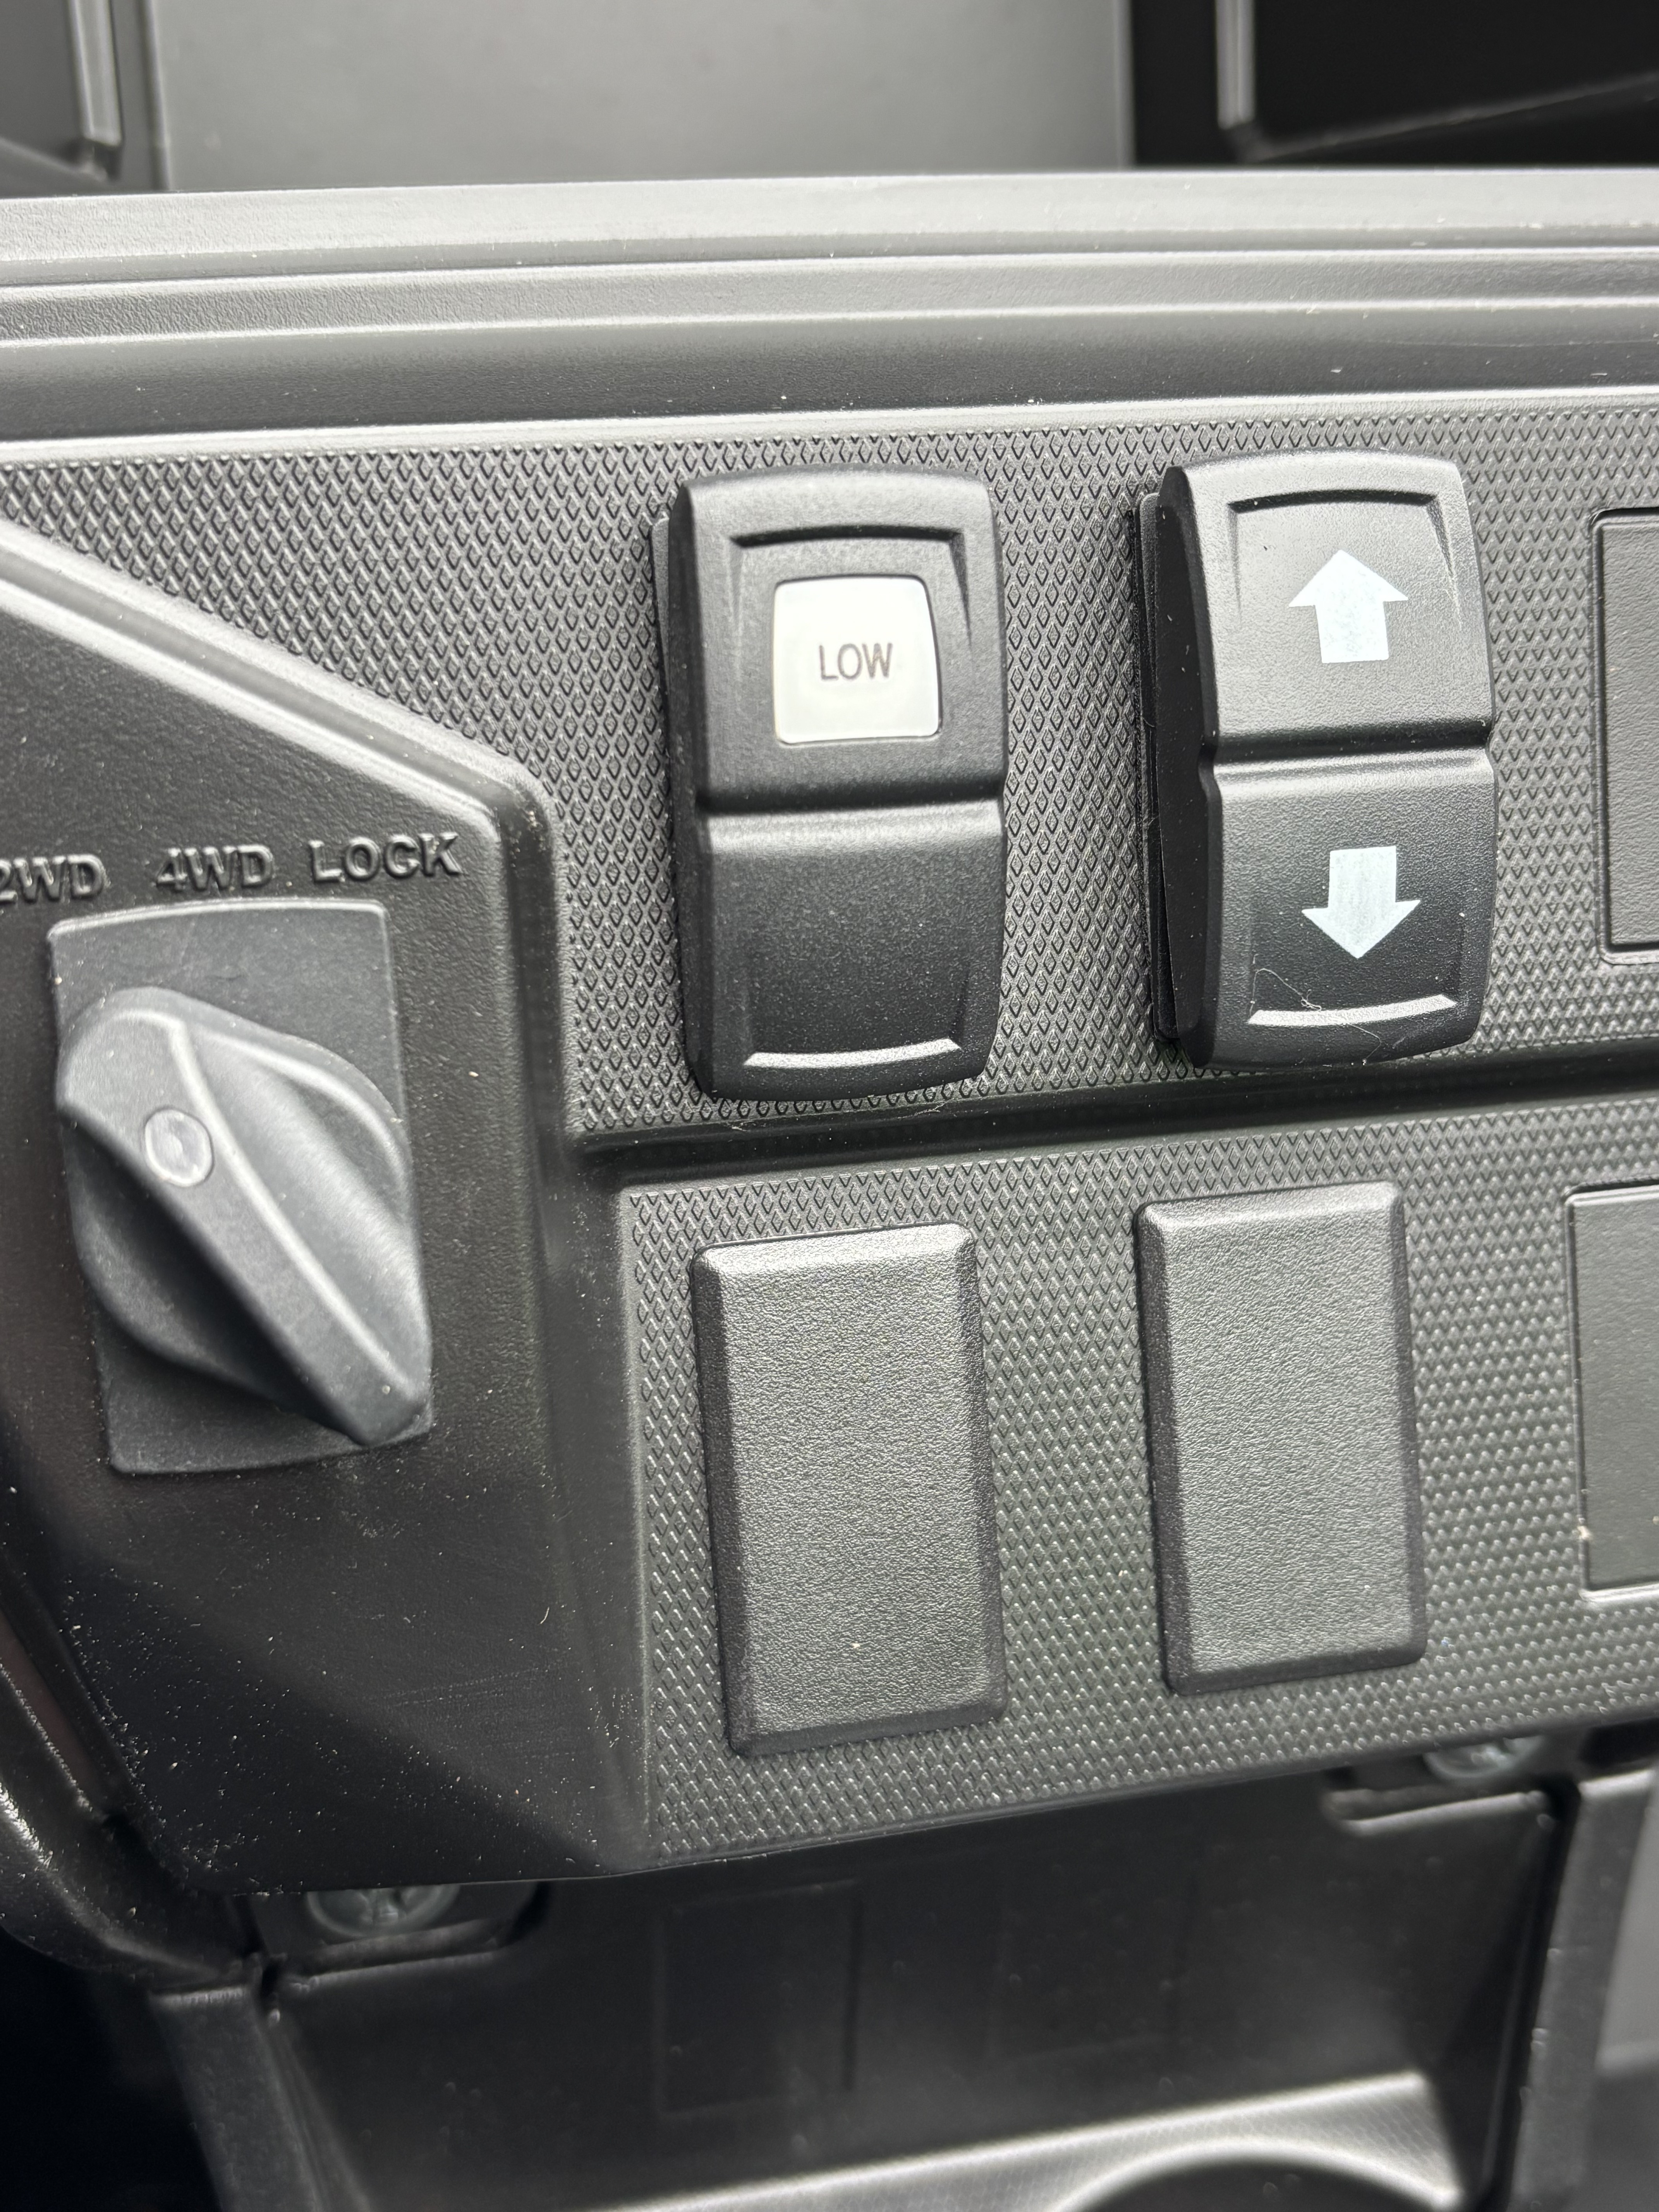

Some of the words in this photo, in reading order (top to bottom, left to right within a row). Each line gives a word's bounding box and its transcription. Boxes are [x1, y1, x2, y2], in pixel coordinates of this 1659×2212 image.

[819, 642, 893, 680] LOW
[156, 844, 273, 891] 4WD
[309, 831, 462, 883] LOCK
